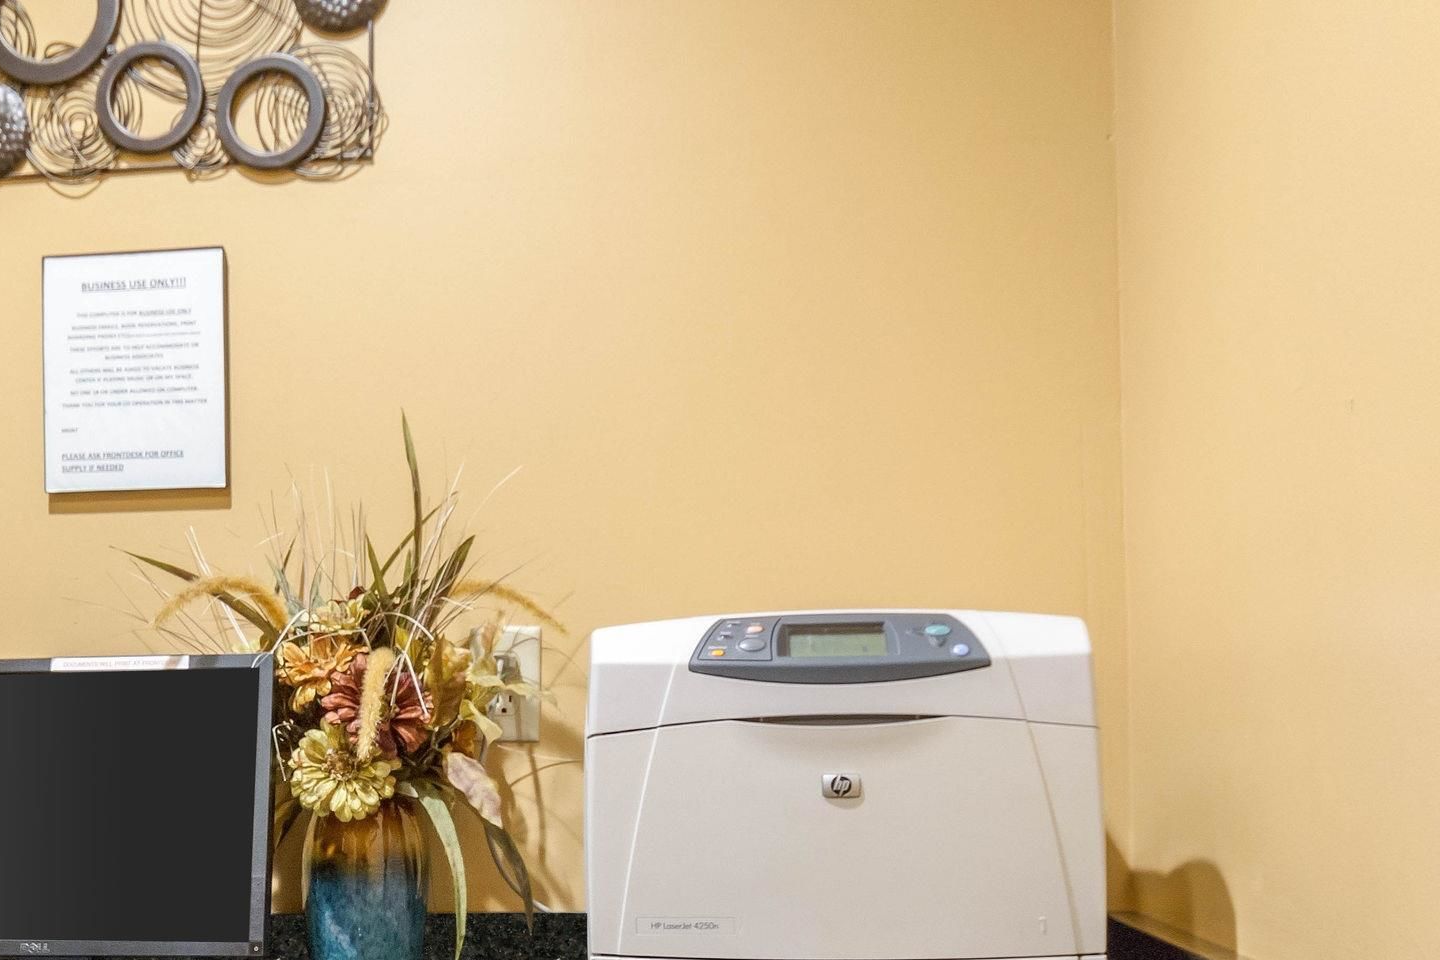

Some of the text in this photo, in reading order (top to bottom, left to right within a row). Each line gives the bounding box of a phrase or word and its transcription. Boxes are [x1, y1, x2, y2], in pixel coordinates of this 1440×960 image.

[81, 279, 127, 292] BUSINESS
[128, 278, 147, 290] USE
[61, 452, 86, 462] PLEASE
[88, 451, 101, 461] ASK
[145, 449, 159, 459] FOR
[160, 449, 185, 459] OFFICE
[61, 464, 87, 474] SUPPLY
[97, 463, 125, 472] NEEDED
[830, 774, 853, 798] hp
[693, 921, 720, 930] 4250n
